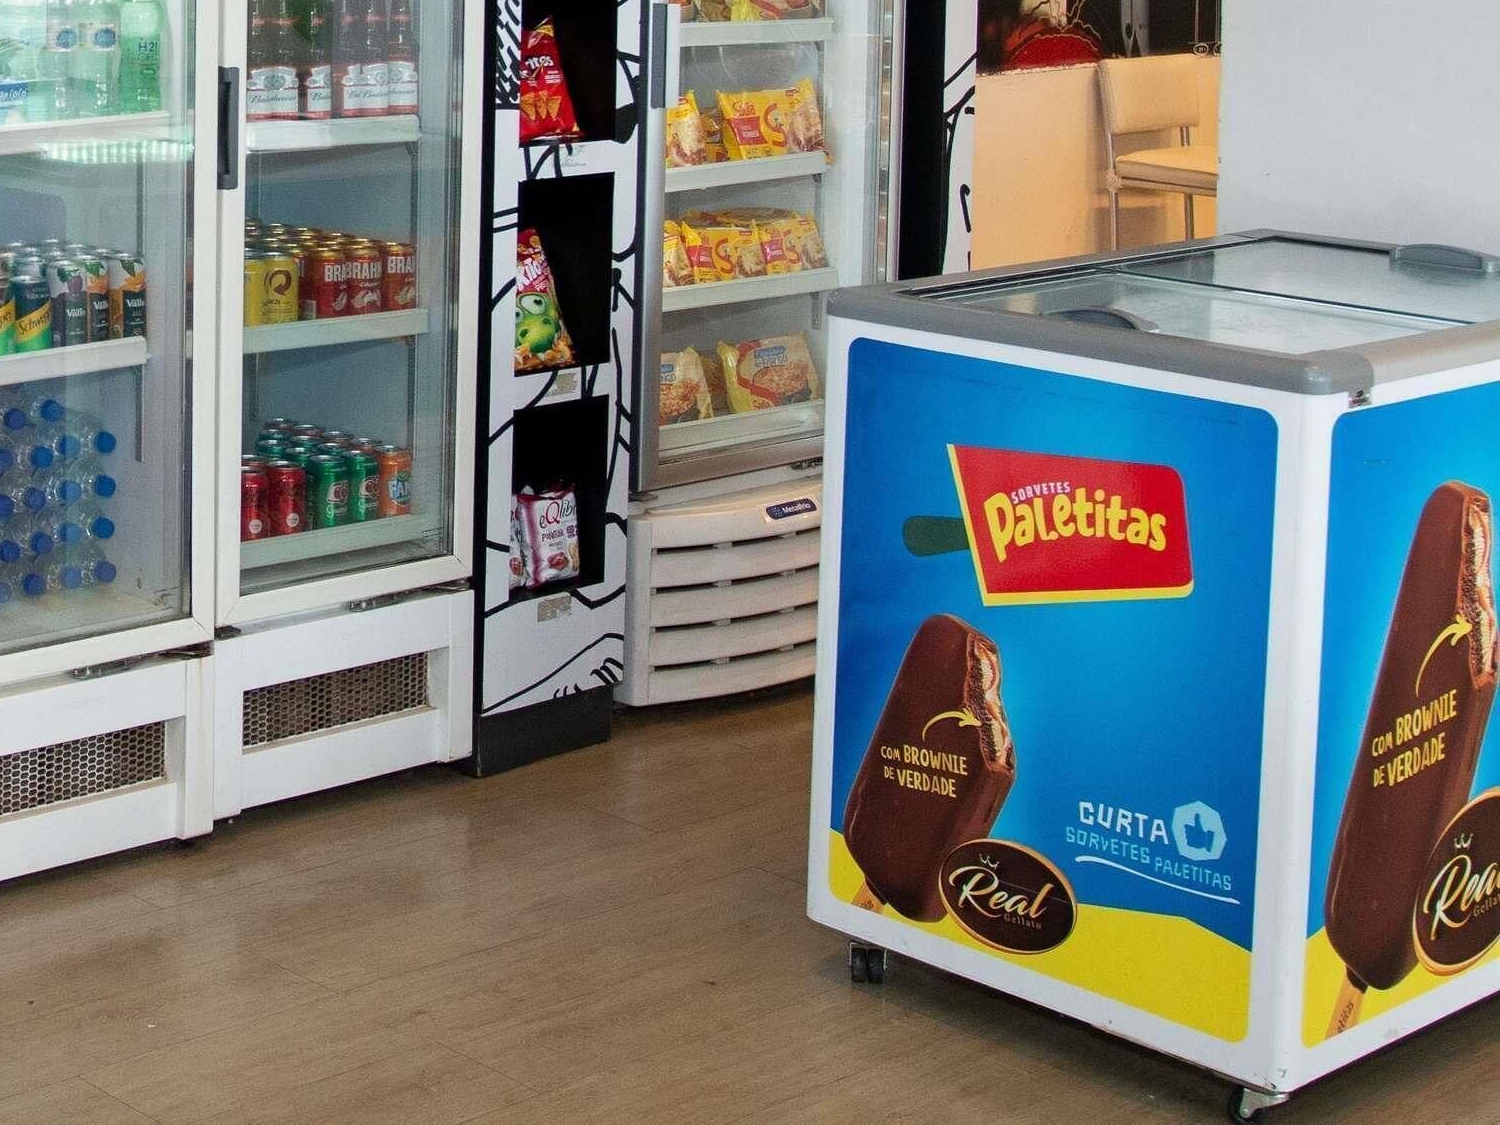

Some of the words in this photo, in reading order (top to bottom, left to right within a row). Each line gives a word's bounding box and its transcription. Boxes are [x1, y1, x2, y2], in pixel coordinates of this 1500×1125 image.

[1011, 481, 1071, 504] SORVETES
[984, 487, 1167, 563] Paletitas
[1372, 733, 1394, 758] COM
[1395, 689, 1458, 747] BROWNIE
[880, 745, 901, 761] COM
[903, 744, 968, 775] BROWNIE
[884, 765, 895, 780] DE
[896, 768, 957, 798] VERDADE
[1373, 765, 1385, 788] DE
[1387, 732, 1446, 787] VERDADE
[1079, 801, 1170, 845] CURTA
[1065, 826, 1151, 864] SORVETES
[1154, 857, 1232, 891] PALETITAS
[948, 865, 1054, 920] Real
